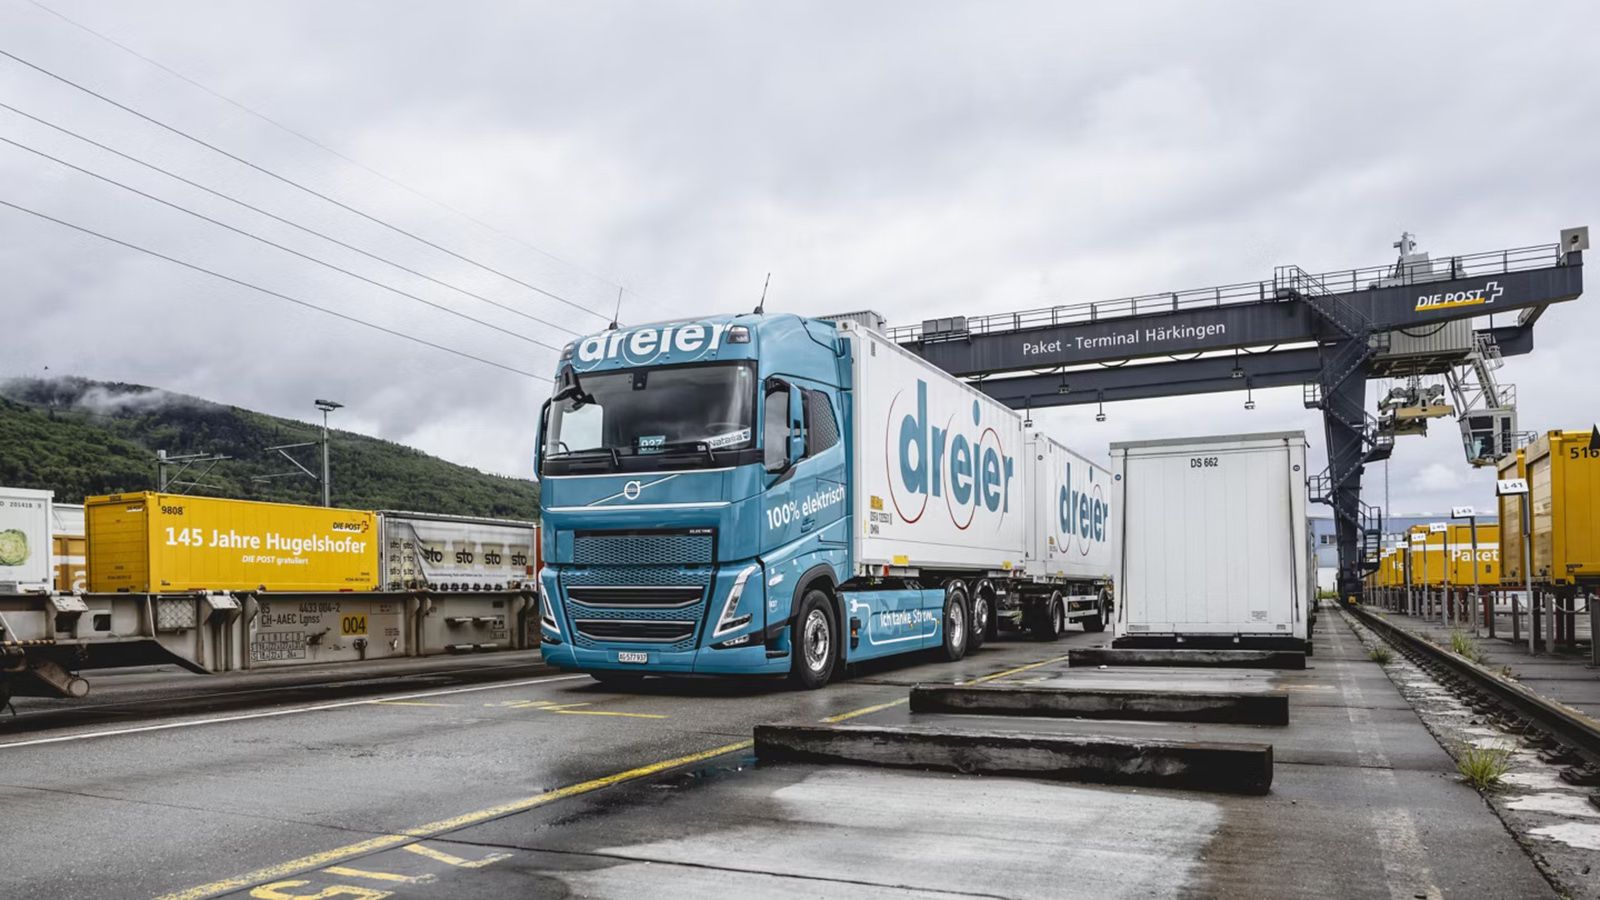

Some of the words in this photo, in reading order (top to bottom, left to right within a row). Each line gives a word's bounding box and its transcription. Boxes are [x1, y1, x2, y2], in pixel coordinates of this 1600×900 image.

[1417, 293, 1442, 307] DIE
[1444, 288, 1484, 304] POST
[1023, 339, 1062, 355] Paket
[1075, 329, 1139, 350] Terminal
[1145, 323, 1226, 342] Härkingen
[900, 378, 1014, 513] dreier
[1570, 446, 1600, 459] 516
[1190, 457, 1202, 468] DS
[1204, 456, 1218, 468] 662
[161, 505, 184, 516] 9808
[766, 499, 801, 530] 100%
[801, 483, 845, 516] elektrisch
[1059, 462, 1108, 542] dreier
[332, 521, 344, 530] DIE
[345, 522, 361, 531] POST
[165, 526, 203, 547] 145
[209, 529, 261, 549] Jahre
[265, 532, 367, 556] Hugelshofer
[242, 555, 255, 563] DIE
[256, 556, 276, 564] POST
[277, 557, 309, 566] gratuliert
[456, 548, 474, 564] sto
[485, 549, 502, 565] sto
[511, 551, 527, 566] sto
[1451, 549, 1499, 562] Paket
[261, 613, 297, 625] CH-AAEC
[342, 616, 367, 634] 004
[880, 611, 892, 627] Ich
[892, 609, 911, 625] tanke
[912, 608, 933, 624] Strom
